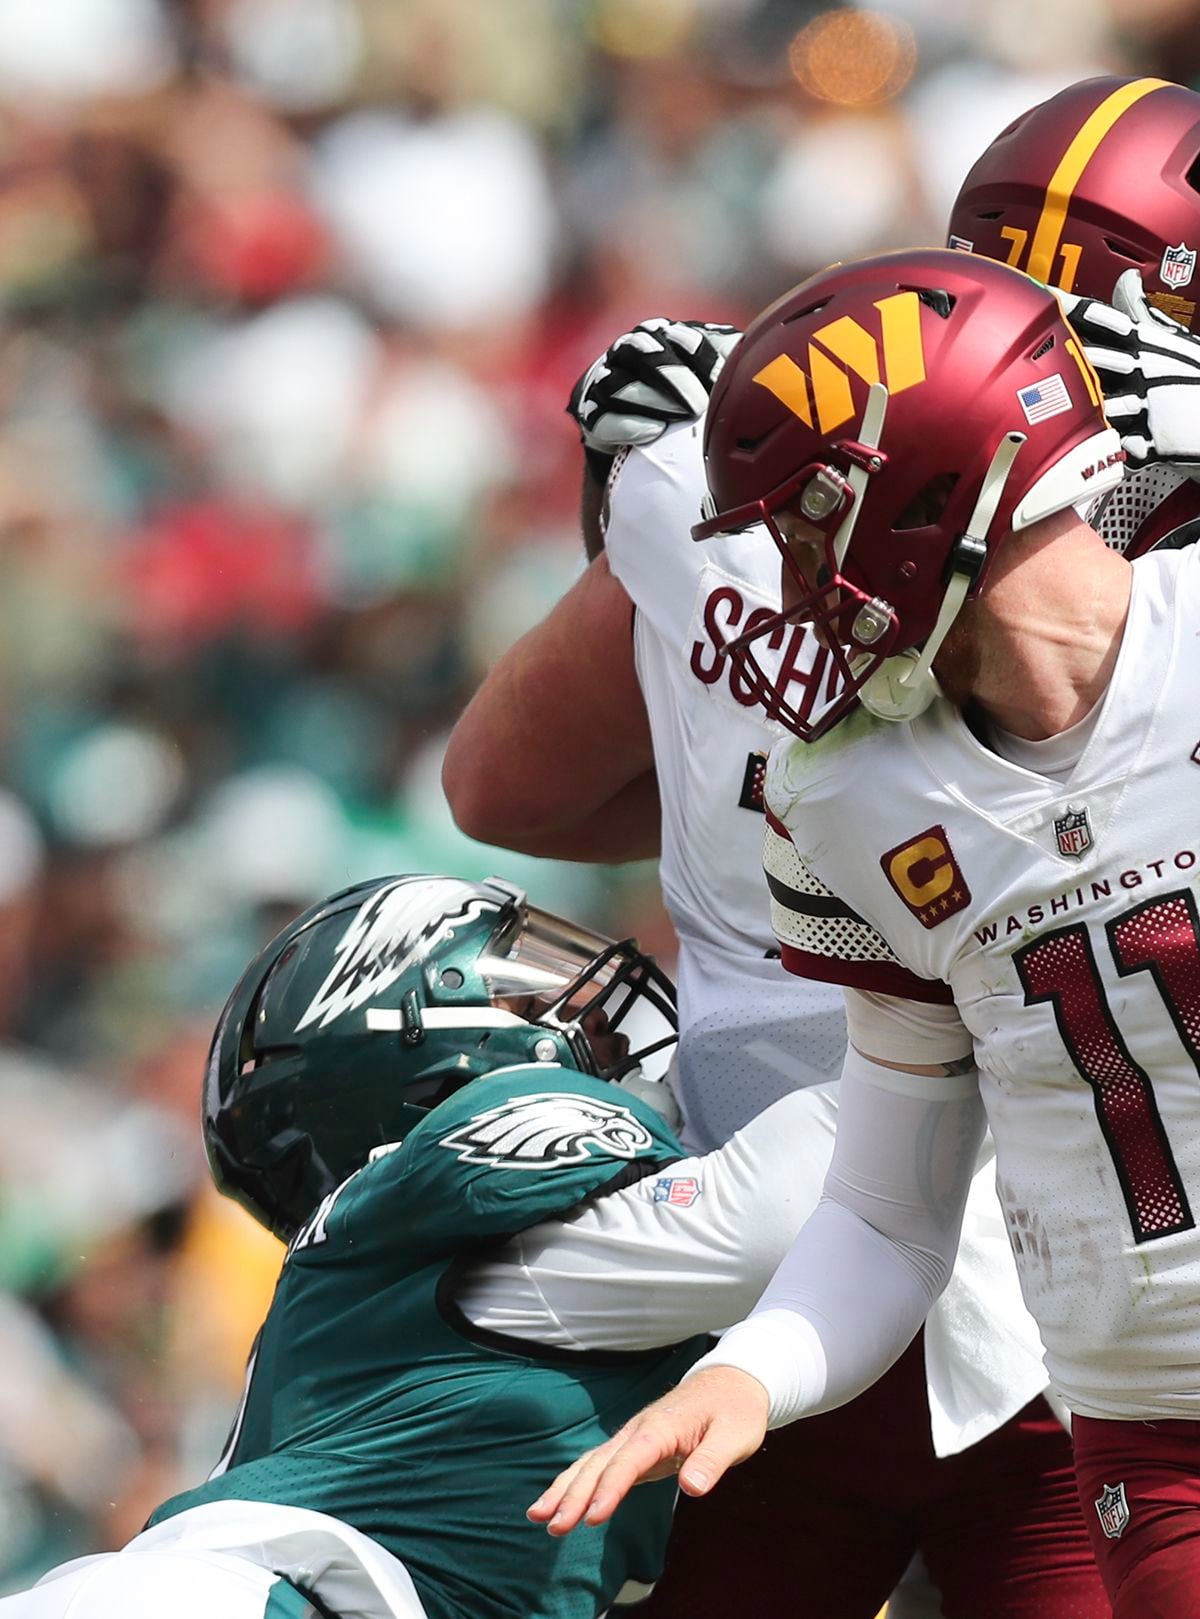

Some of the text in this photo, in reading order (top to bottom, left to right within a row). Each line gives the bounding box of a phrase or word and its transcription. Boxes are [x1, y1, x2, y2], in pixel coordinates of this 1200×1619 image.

[1165, 261, 1190, 281] NFL
[690, 586, 846, 721] SCH
[1060, 828, 1089, 853] NFL
[890, 836, 954, 907] C
[1104, 1505, 1125, 1530] NFL
